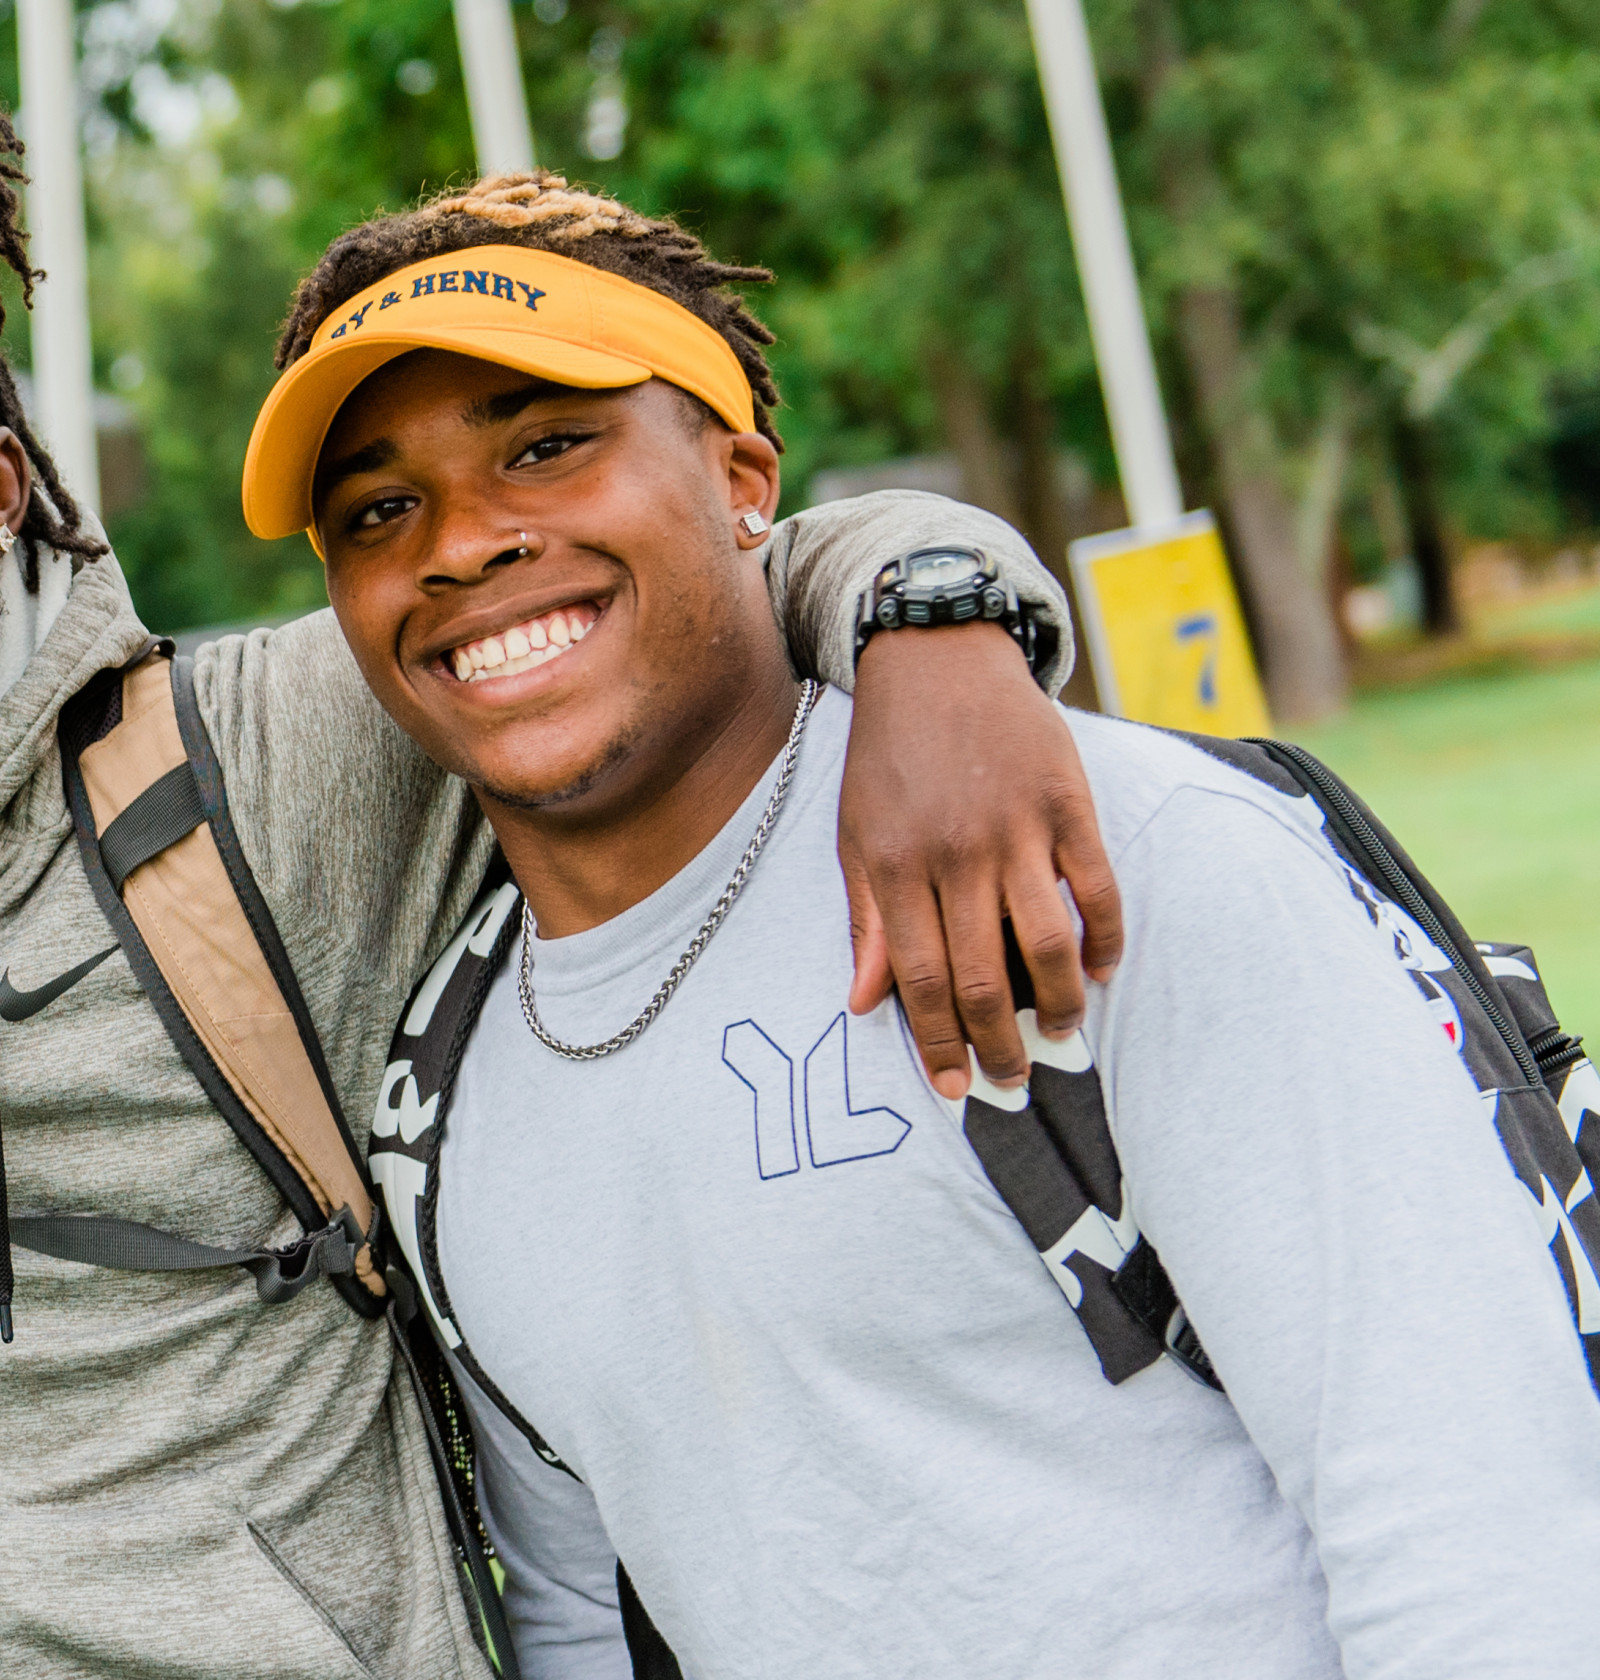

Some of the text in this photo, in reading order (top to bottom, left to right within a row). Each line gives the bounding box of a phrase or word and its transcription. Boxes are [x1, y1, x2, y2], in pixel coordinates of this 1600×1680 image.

[379, 291, 403, 311] &
[410, 270, 547, 312] HENRY
[1175, 616, 1217, 706] 7
